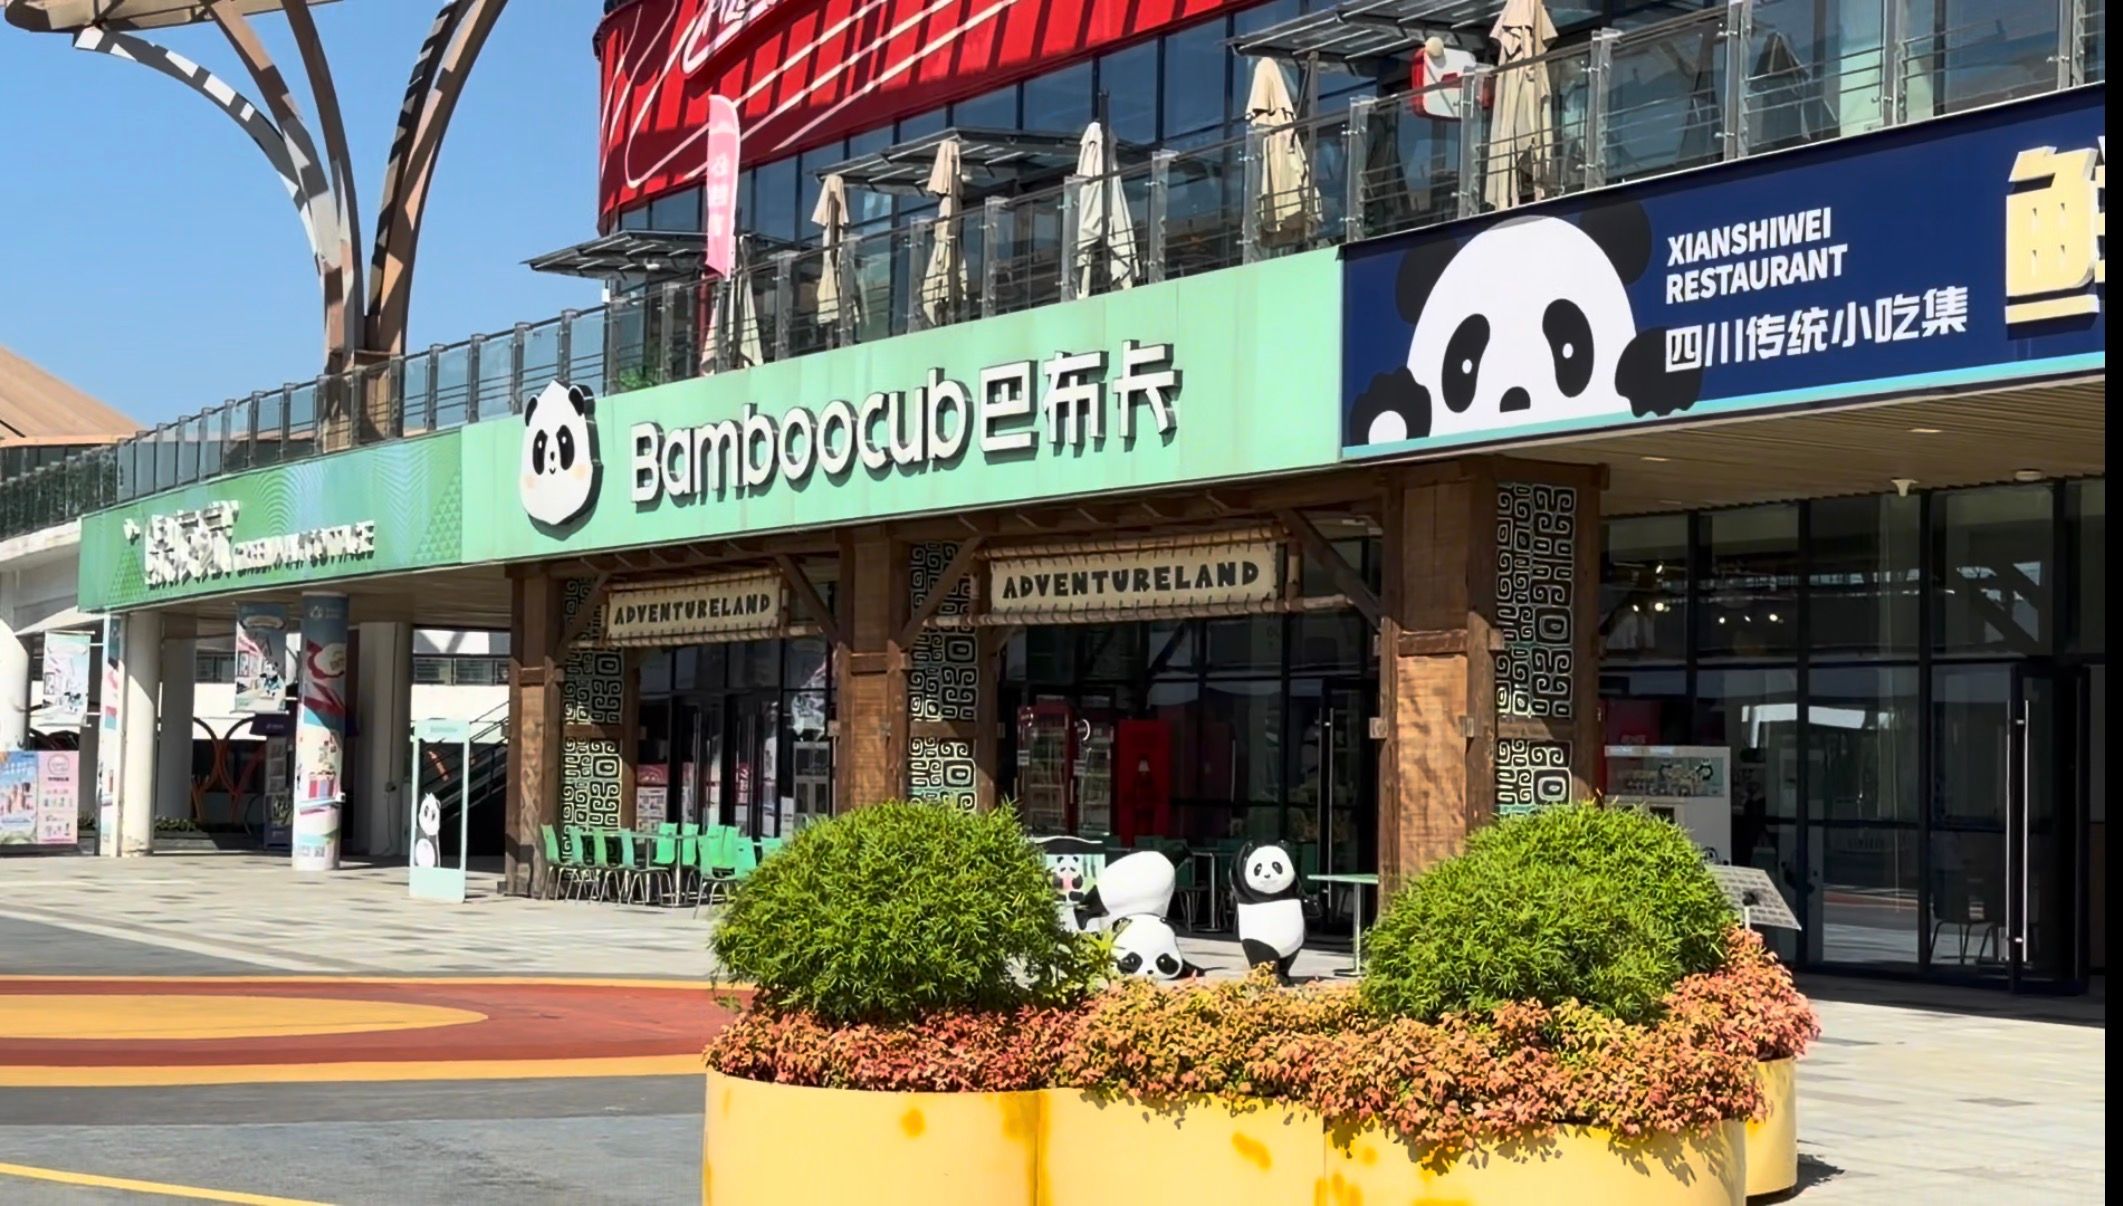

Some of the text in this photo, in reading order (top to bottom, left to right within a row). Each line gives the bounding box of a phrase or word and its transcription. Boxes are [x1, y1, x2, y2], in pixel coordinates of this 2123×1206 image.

[1667, 206, 1832, 267] XIANSHIWEI
[1665, 243, 1848, 304] RESTAURANT
[1665, 285, 1969, 374] 四川传统小吃集
[630, 339, 1183, 504] Bamboocub 巴布卡
[614, 593, 771, 626] ADVENTURELAND
[1002, 560, 1260, 600] ADVENTURELAND
